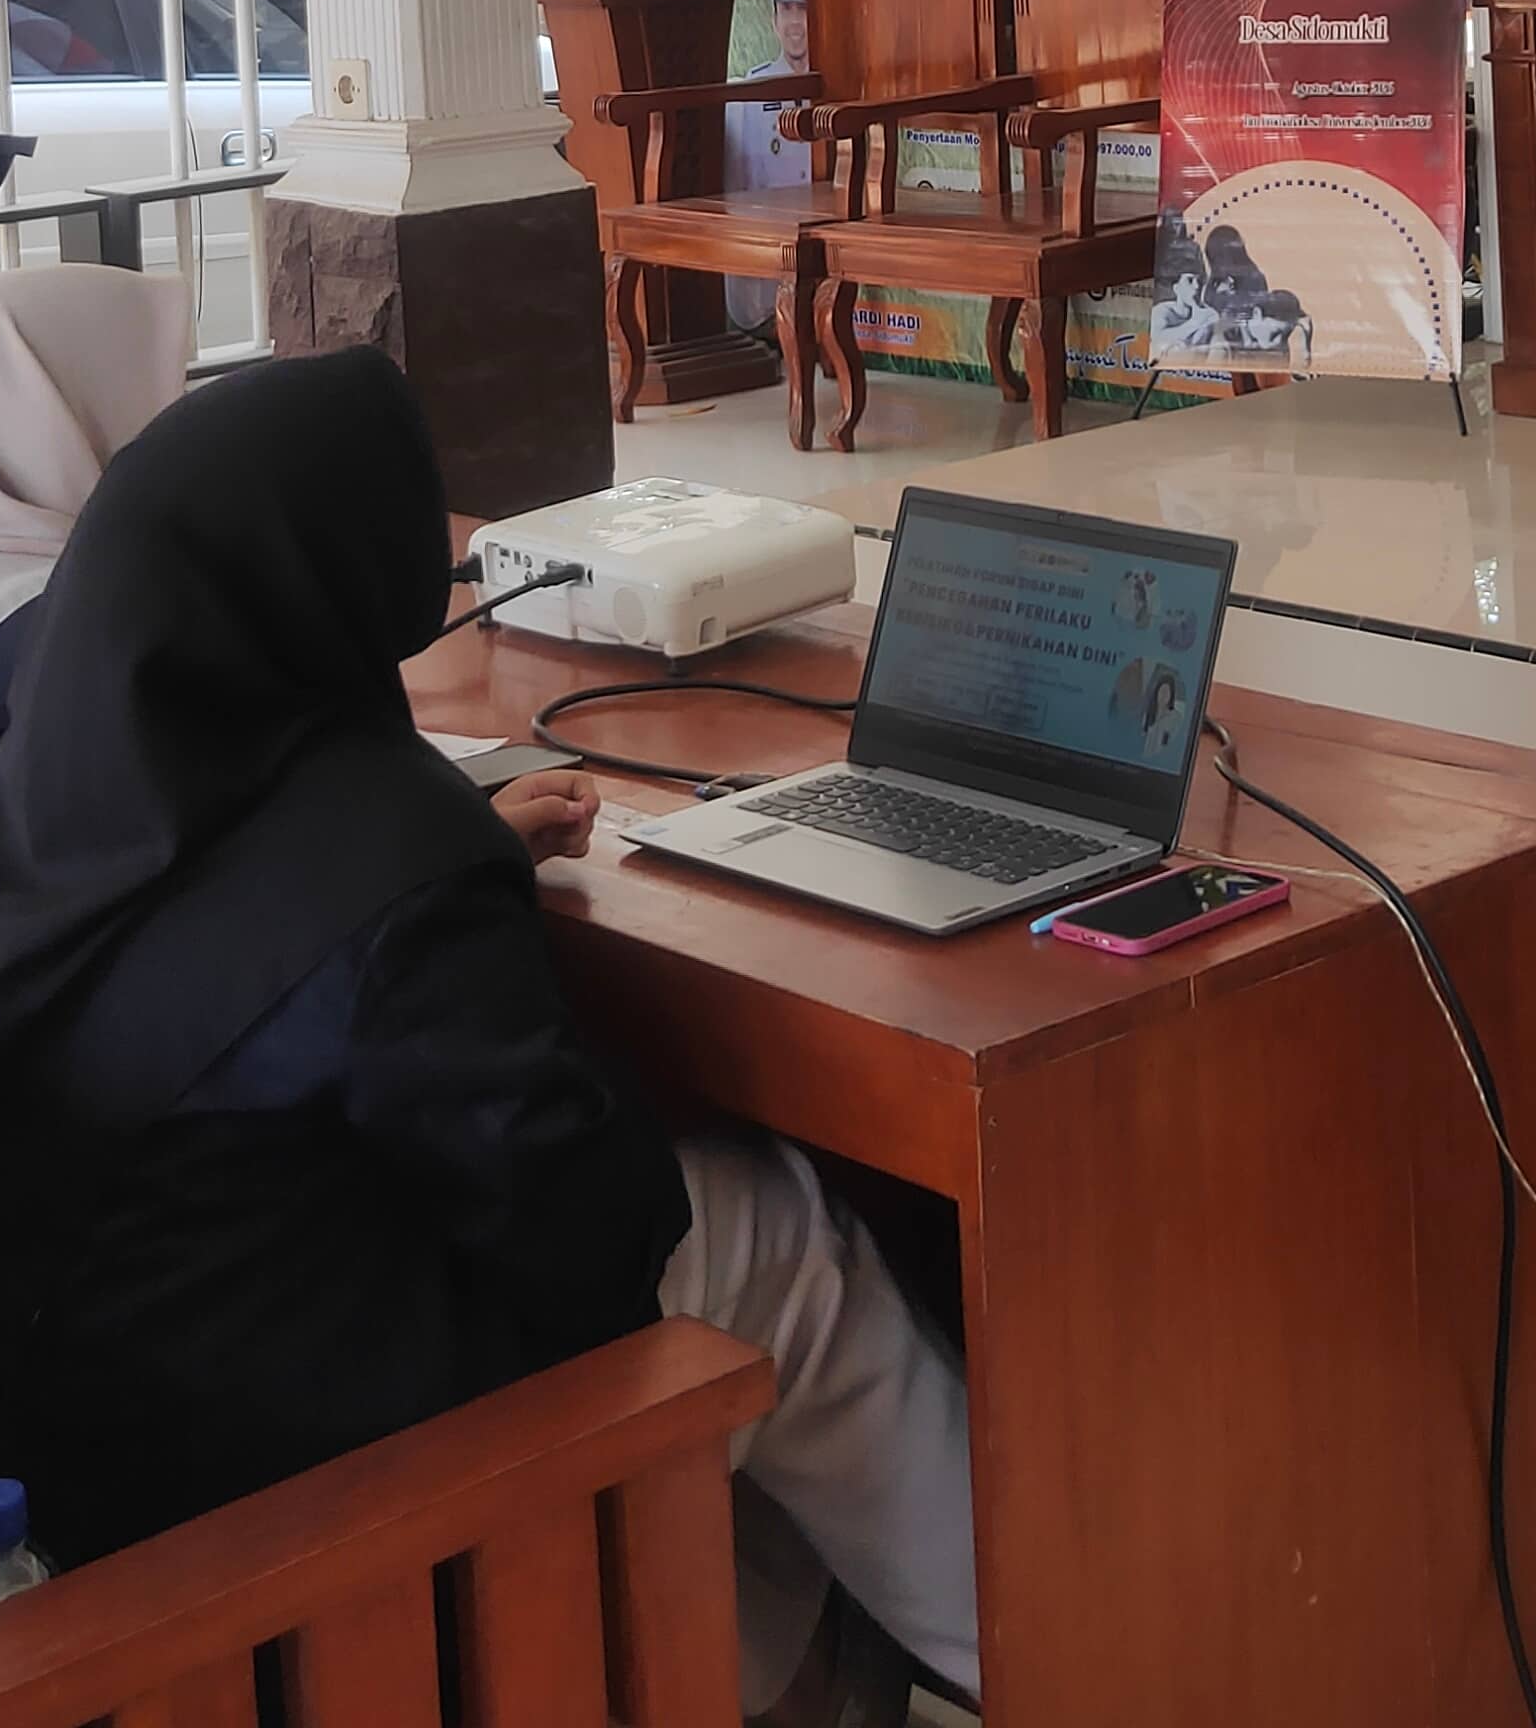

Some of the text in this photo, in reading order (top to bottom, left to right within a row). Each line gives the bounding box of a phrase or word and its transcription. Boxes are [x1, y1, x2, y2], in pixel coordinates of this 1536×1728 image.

[1239, 15, 1389, 43] Desa Sidomukti
[906, 130, 962, 145] Penyertaan
[887, 313, 920, 329] HADI
